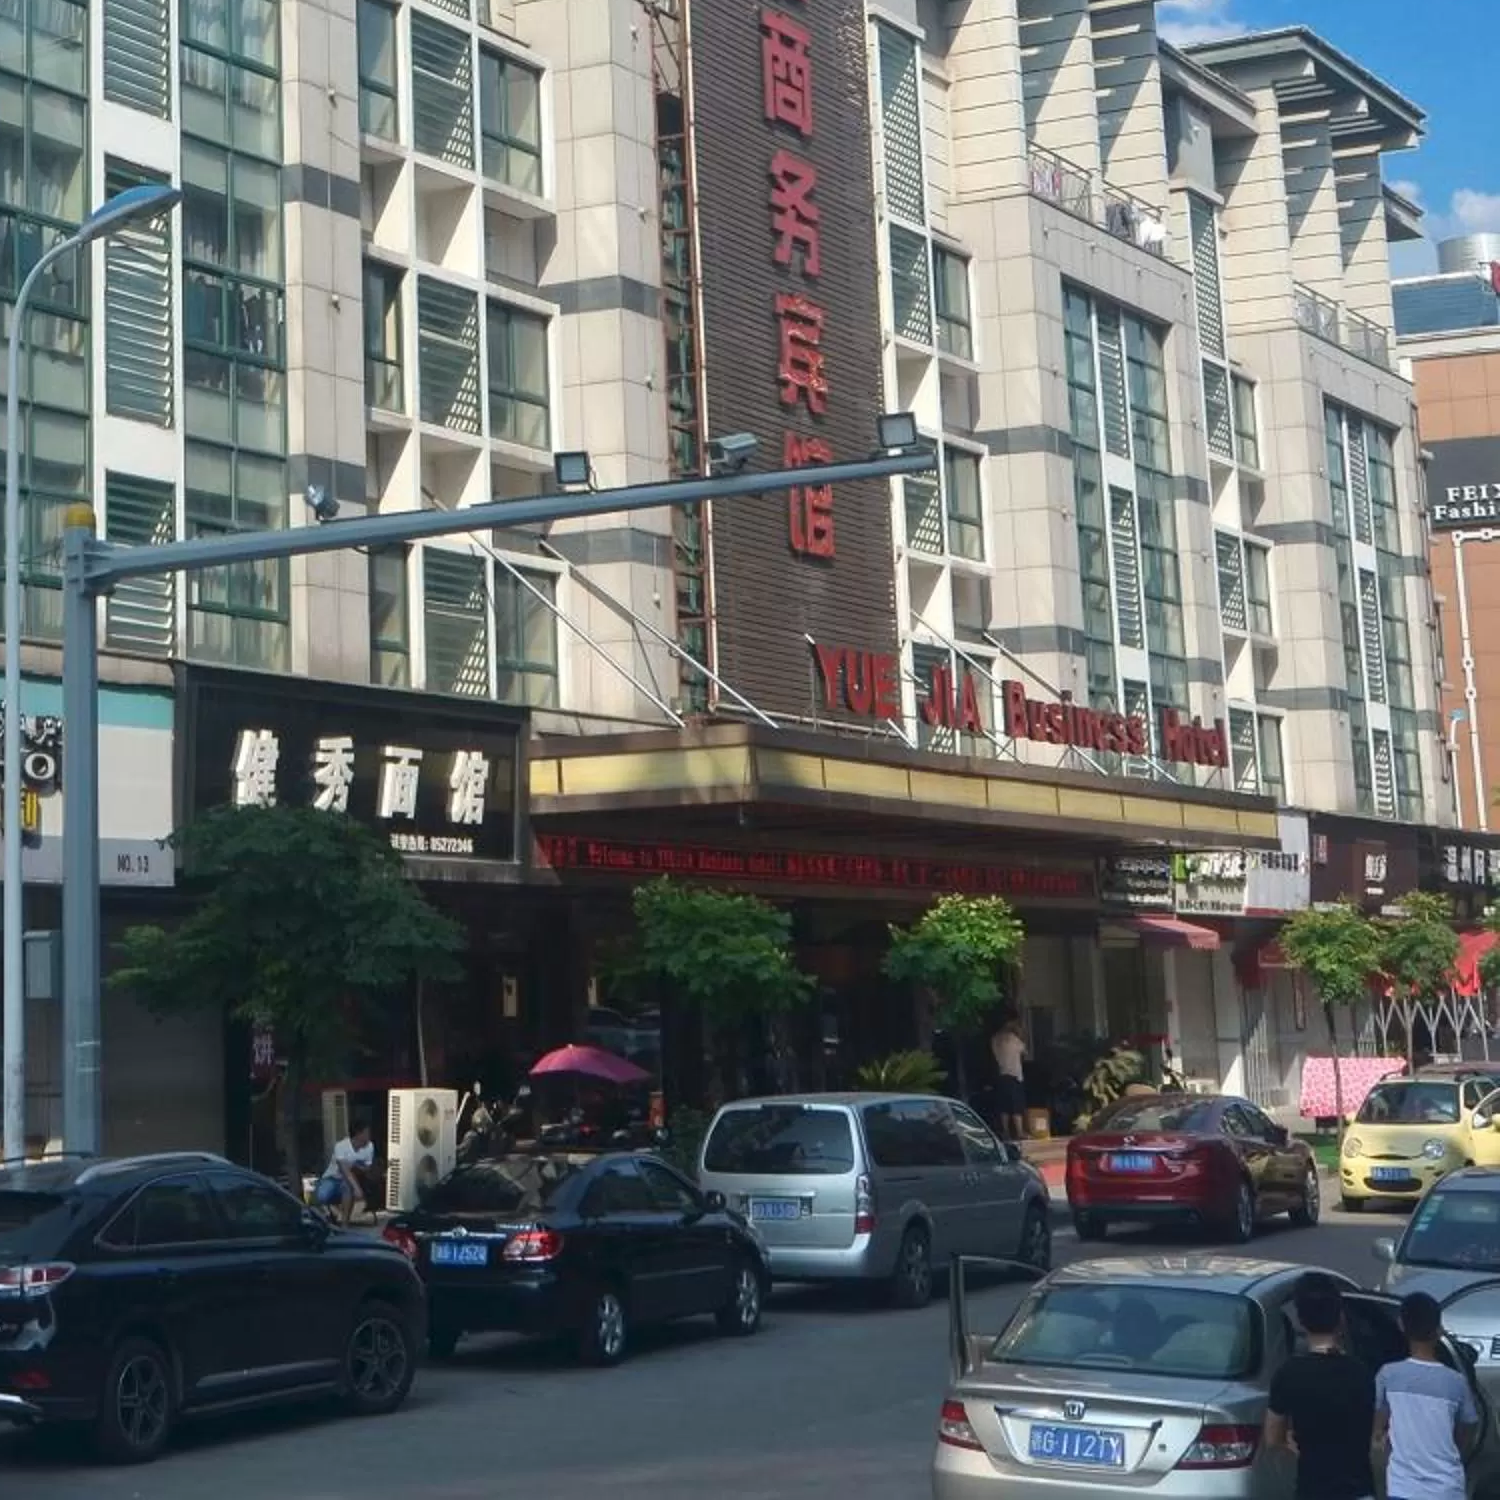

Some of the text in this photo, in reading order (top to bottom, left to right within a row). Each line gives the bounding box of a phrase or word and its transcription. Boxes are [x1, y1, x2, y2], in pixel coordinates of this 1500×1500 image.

[1434, 501, 1500, 521] Fashi
[814, 642, 1229, 769] YUE JIA Business Hotel
